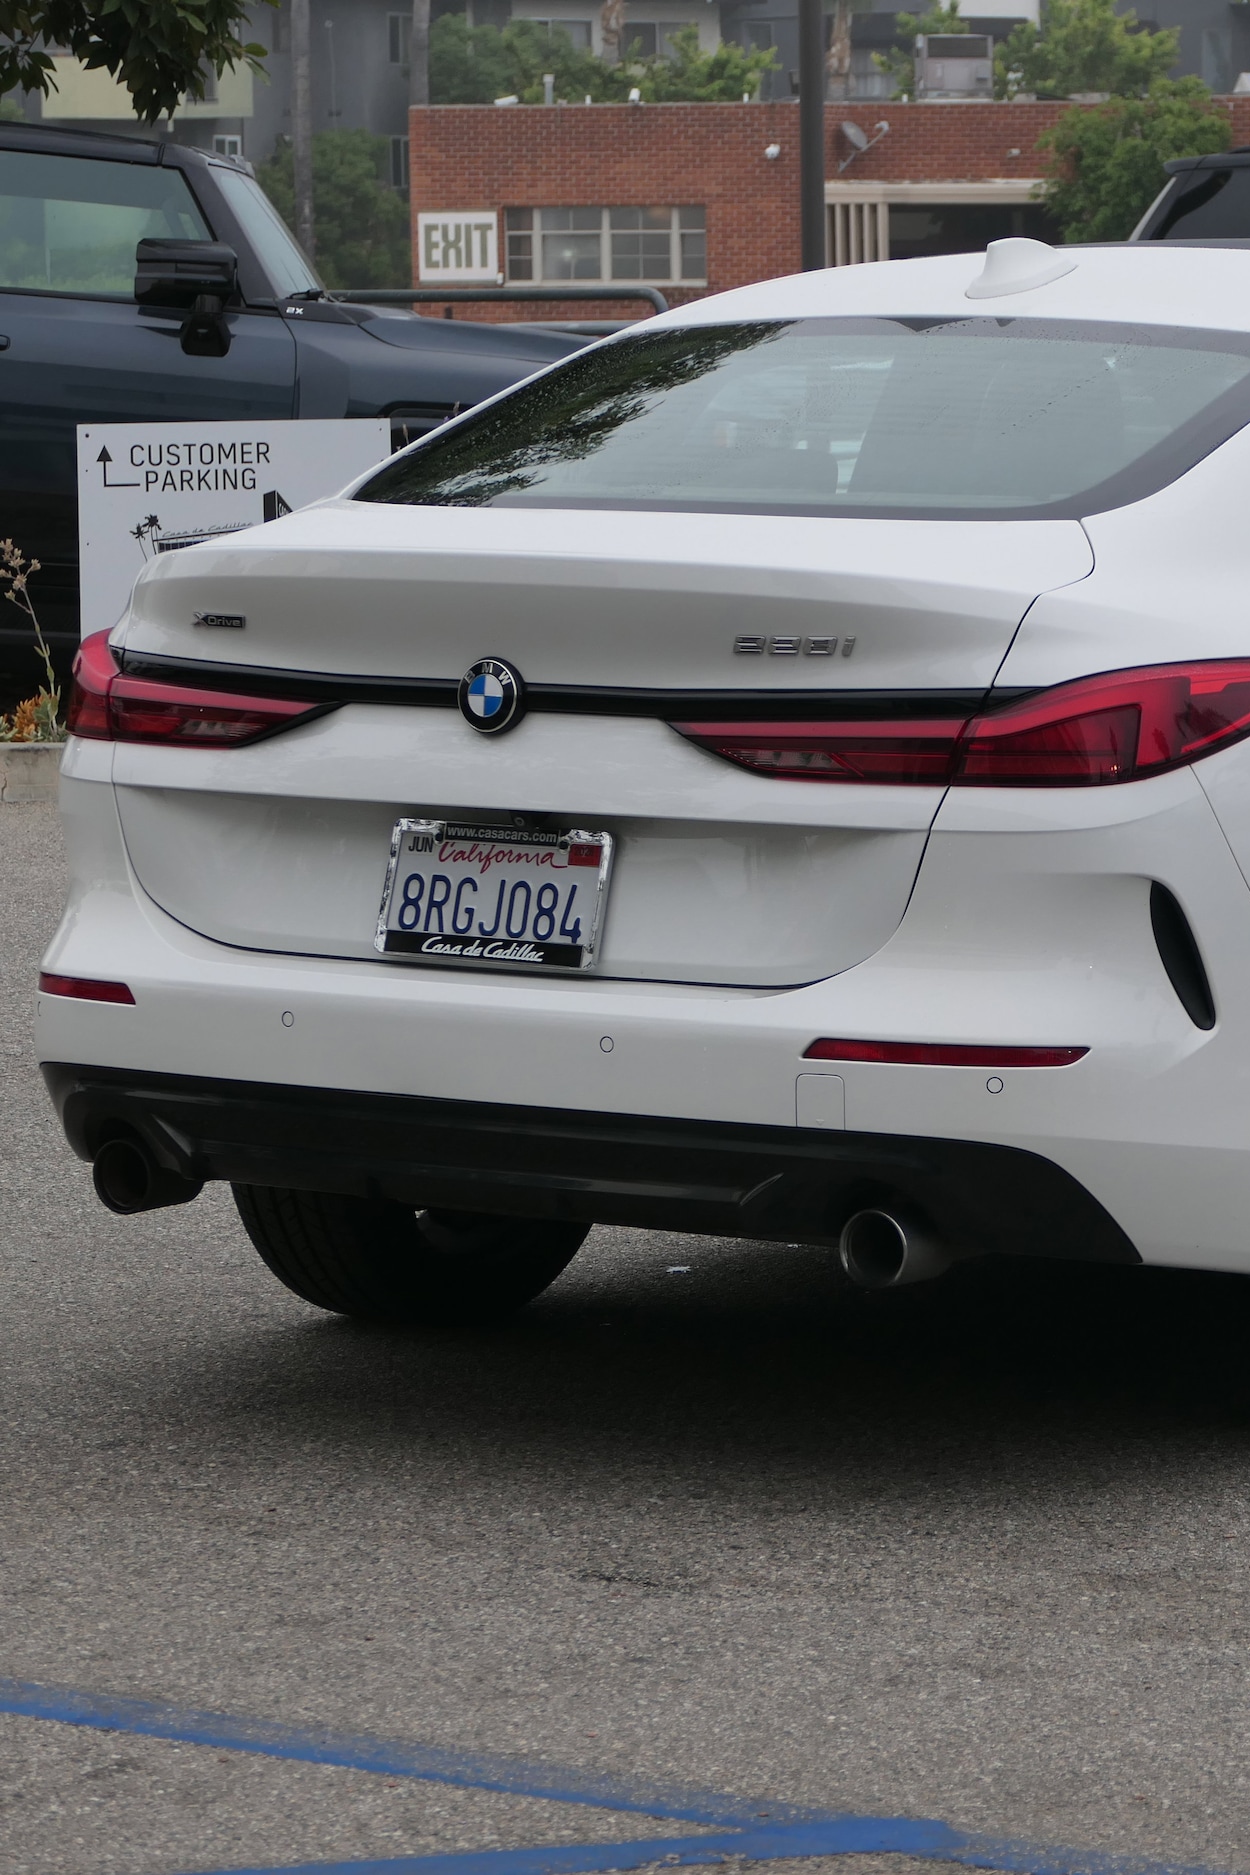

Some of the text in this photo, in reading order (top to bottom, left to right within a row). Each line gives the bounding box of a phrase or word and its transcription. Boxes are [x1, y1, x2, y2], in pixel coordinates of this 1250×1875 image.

[424, 223, 493, 268] EXIT
[130, 442, 270, 467] CUSTOMER
[145, 468, 256, 492] PARKING
[208, 521, 254, 532] Cadillac
[464, 662, 511, 685] BMW
[408, 836, 433, 853] JUN
[447, 826, 557, 842] www.casacars.com
[438, 841, 568, 874] California
[398, 872, 582, 943] 8RGJ084
[421, 936, 544, 962] Casa de Cadillac
